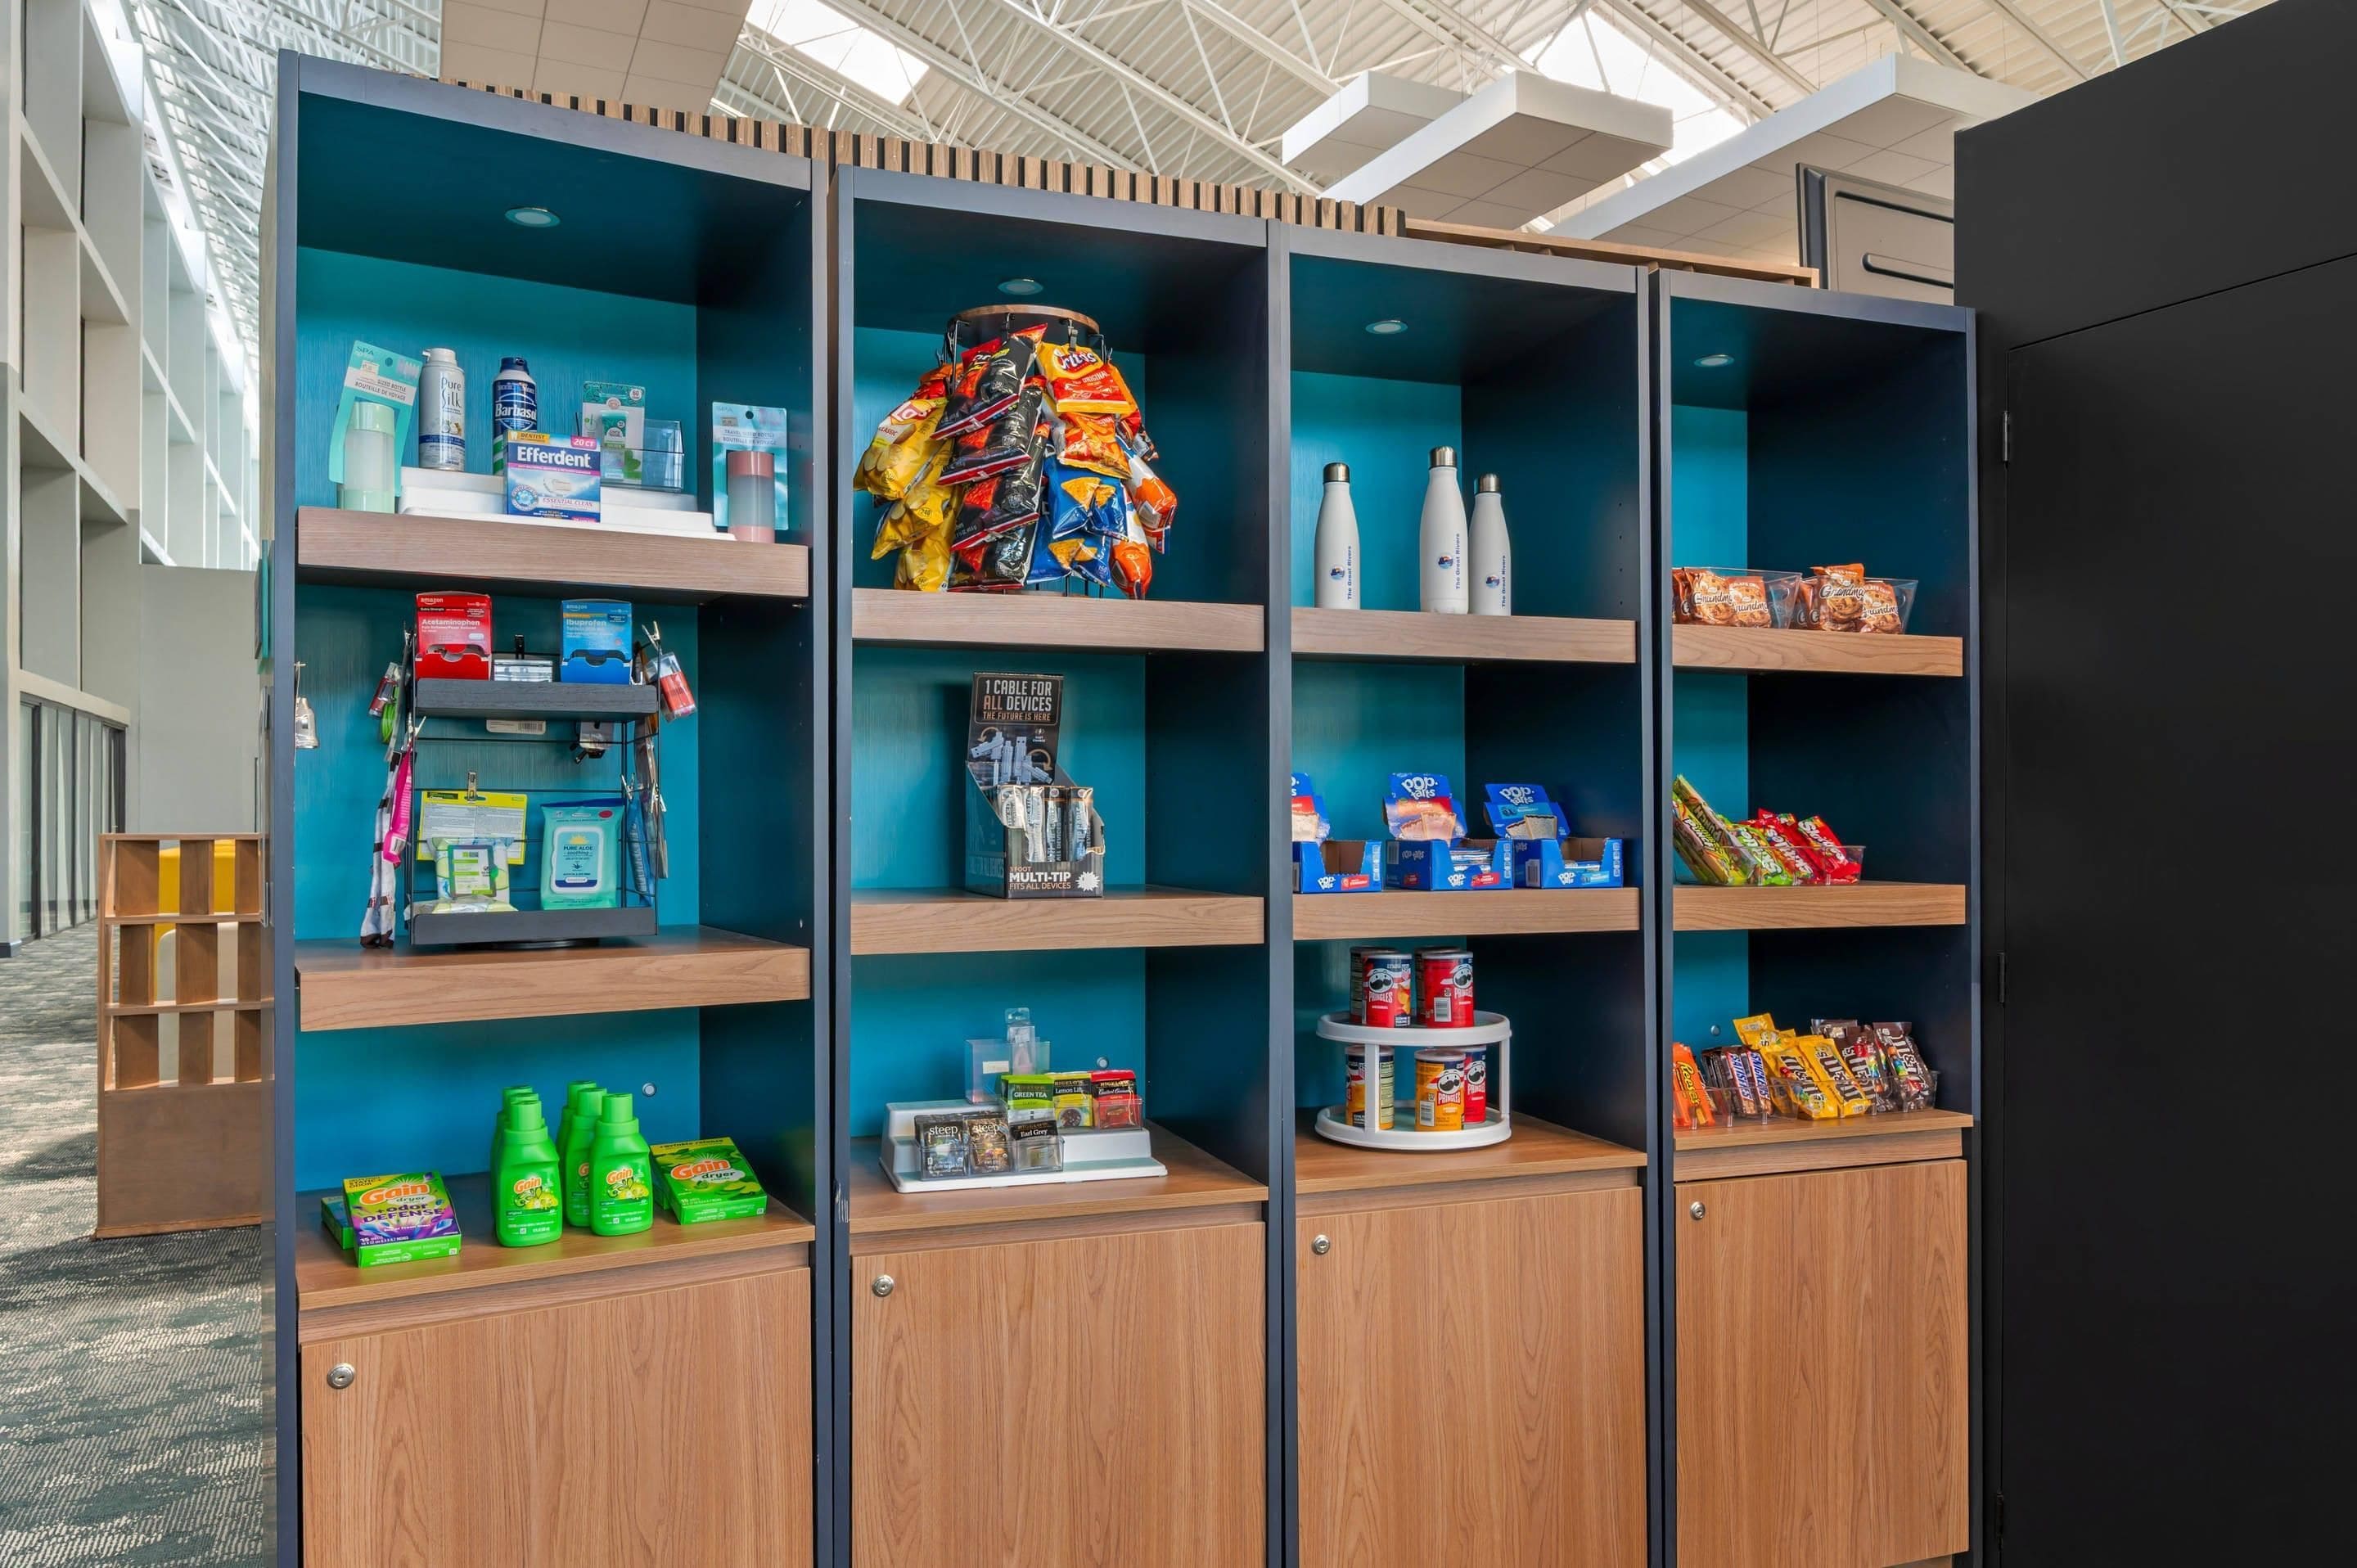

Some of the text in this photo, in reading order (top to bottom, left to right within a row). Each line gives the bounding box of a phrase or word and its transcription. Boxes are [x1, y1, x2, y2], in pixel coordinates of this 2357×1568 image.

[355, 346, 374, 355] SPA
[354, 381, 381, 394] BOUTEILLE
[388, 390, 406, 401] VOYAGE
[391, 383, 407, 392] BOTTLE
[441, 376, 462, 391] Pure
[442, 388, 462, 408] Silk
[495, 403, 538, 420] Barbasol
[517, 446, 591, 468] Efferdent
[543, 498, 593, 507] ESSENTIAL CLEAN
[421, 619, 480, 627] Acetaminophen
[985, 680, 1052, 696] 1 CABLE FOR
[984, 695, 1052, 711] ALL DEVICES
[998, 712, 1024, 720] FUTURE
[1798, 821, 1849, 866] Skittles
[1009, 872, 1071, 882] MULTI-TIP
[1369, 992, 1393, 1003] PRINGLES
[1677, 1061, 1701, 1106] Reese's
[1730, 1052, 1753, 1101] SNICKERS
[1750, 1052, 1771, 1100] SNICKERS
[1438, 1092, 1461, 1104] PRINGLES
[929, 1125, 958, 1136] steep
[973, 1124, 999, 1134] steep
[1034, 1129, 1048, 1137] Grey
[606, 1168, 633, 1184] Gain
[670, 1160, 731, 1179] Gain
[360, 1183, 430, 1205] Gain
[514, 1178, 542, 1194] Gain
[363, 1208, 445, 1223] DEFENSE
